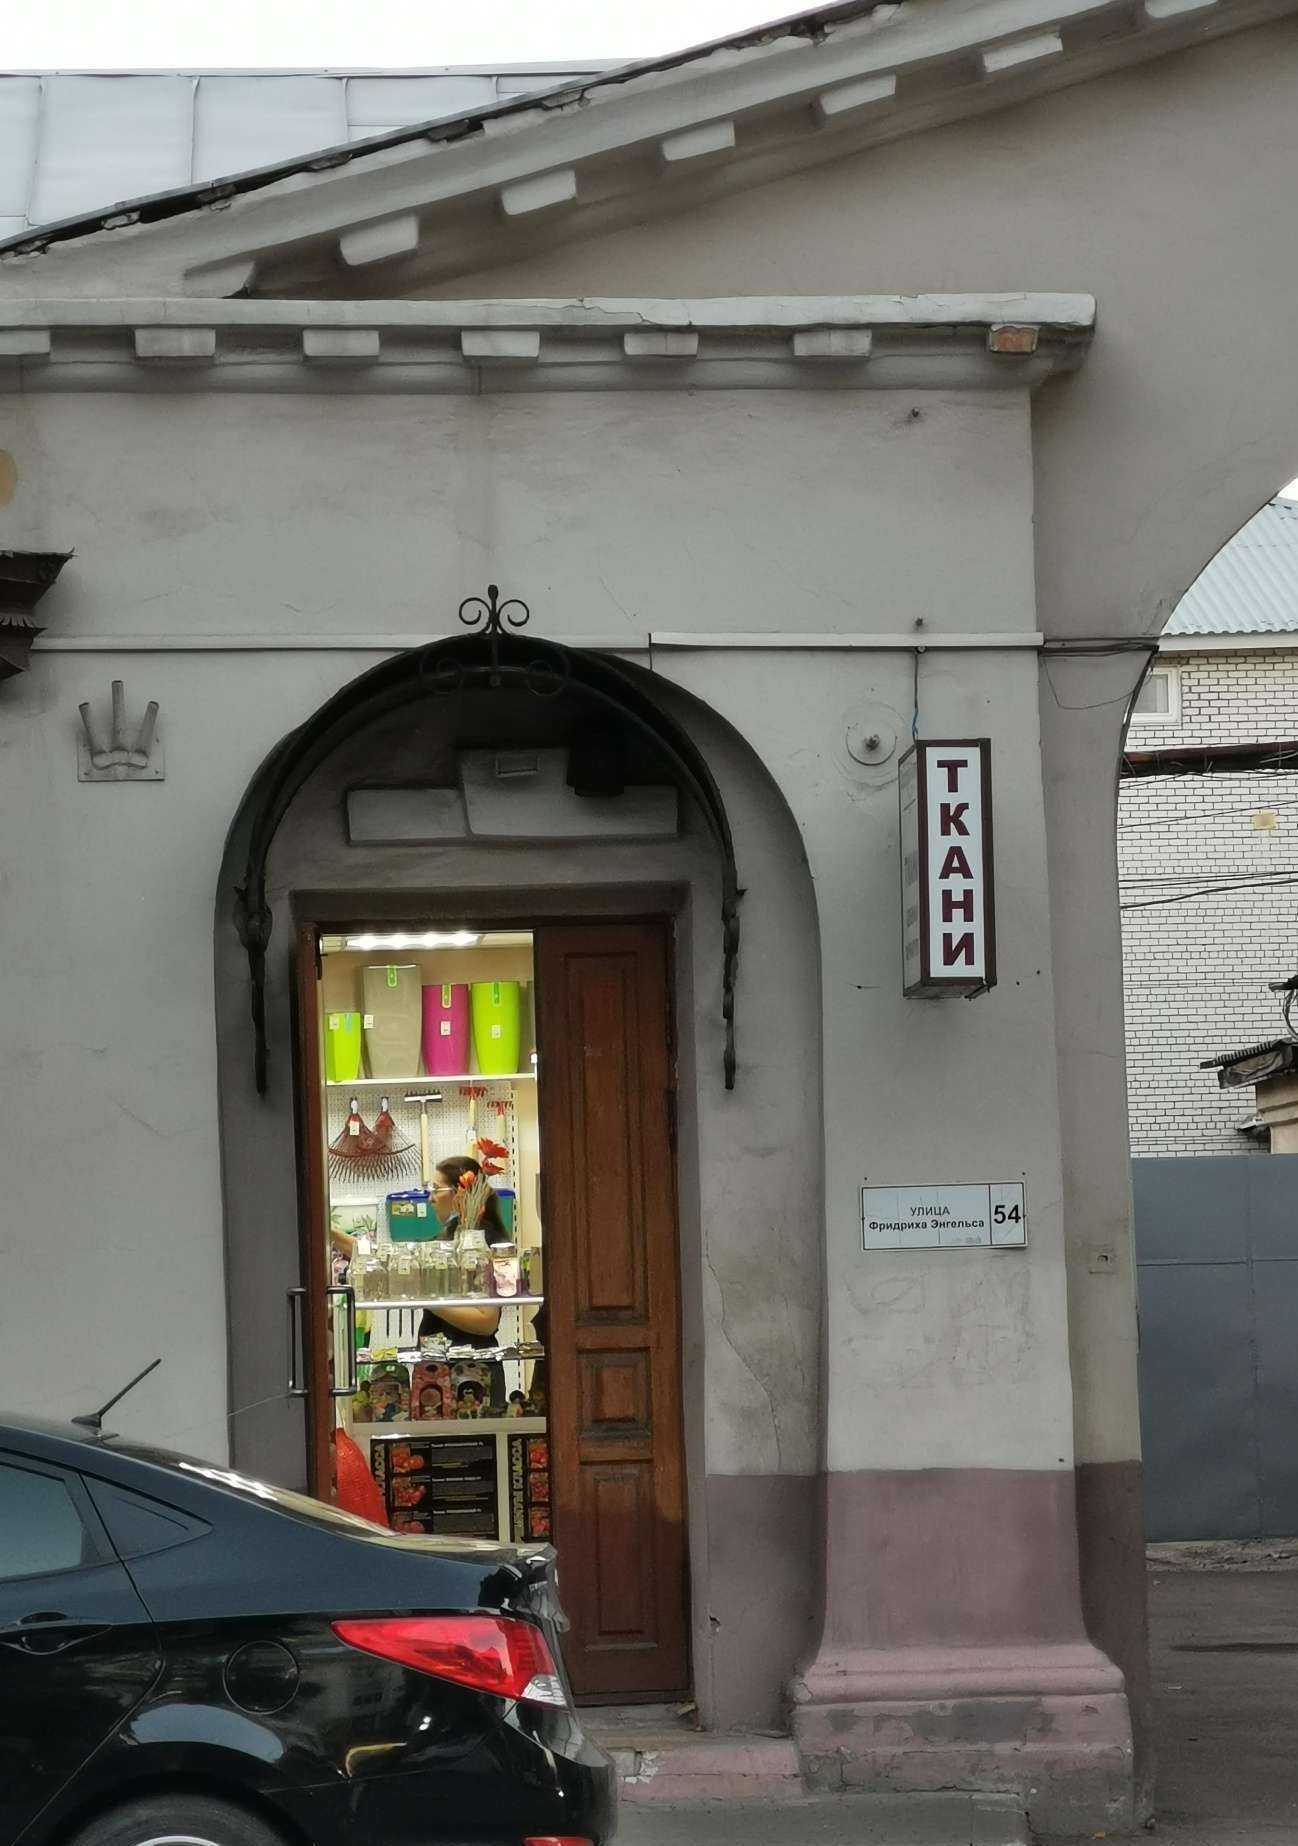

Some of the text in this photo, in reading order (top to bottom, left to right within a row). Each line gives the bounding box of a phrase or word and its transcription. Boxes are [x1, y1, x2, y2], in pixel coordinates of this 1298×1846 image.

[937, 760, 974, 965] ТКАНИ
[910, 1206, 950, 1216] УЛИЦА
[993, 1204, 1021, 1224] 54
[869, 1219, 985, 1232] Фридриха Энгельса
